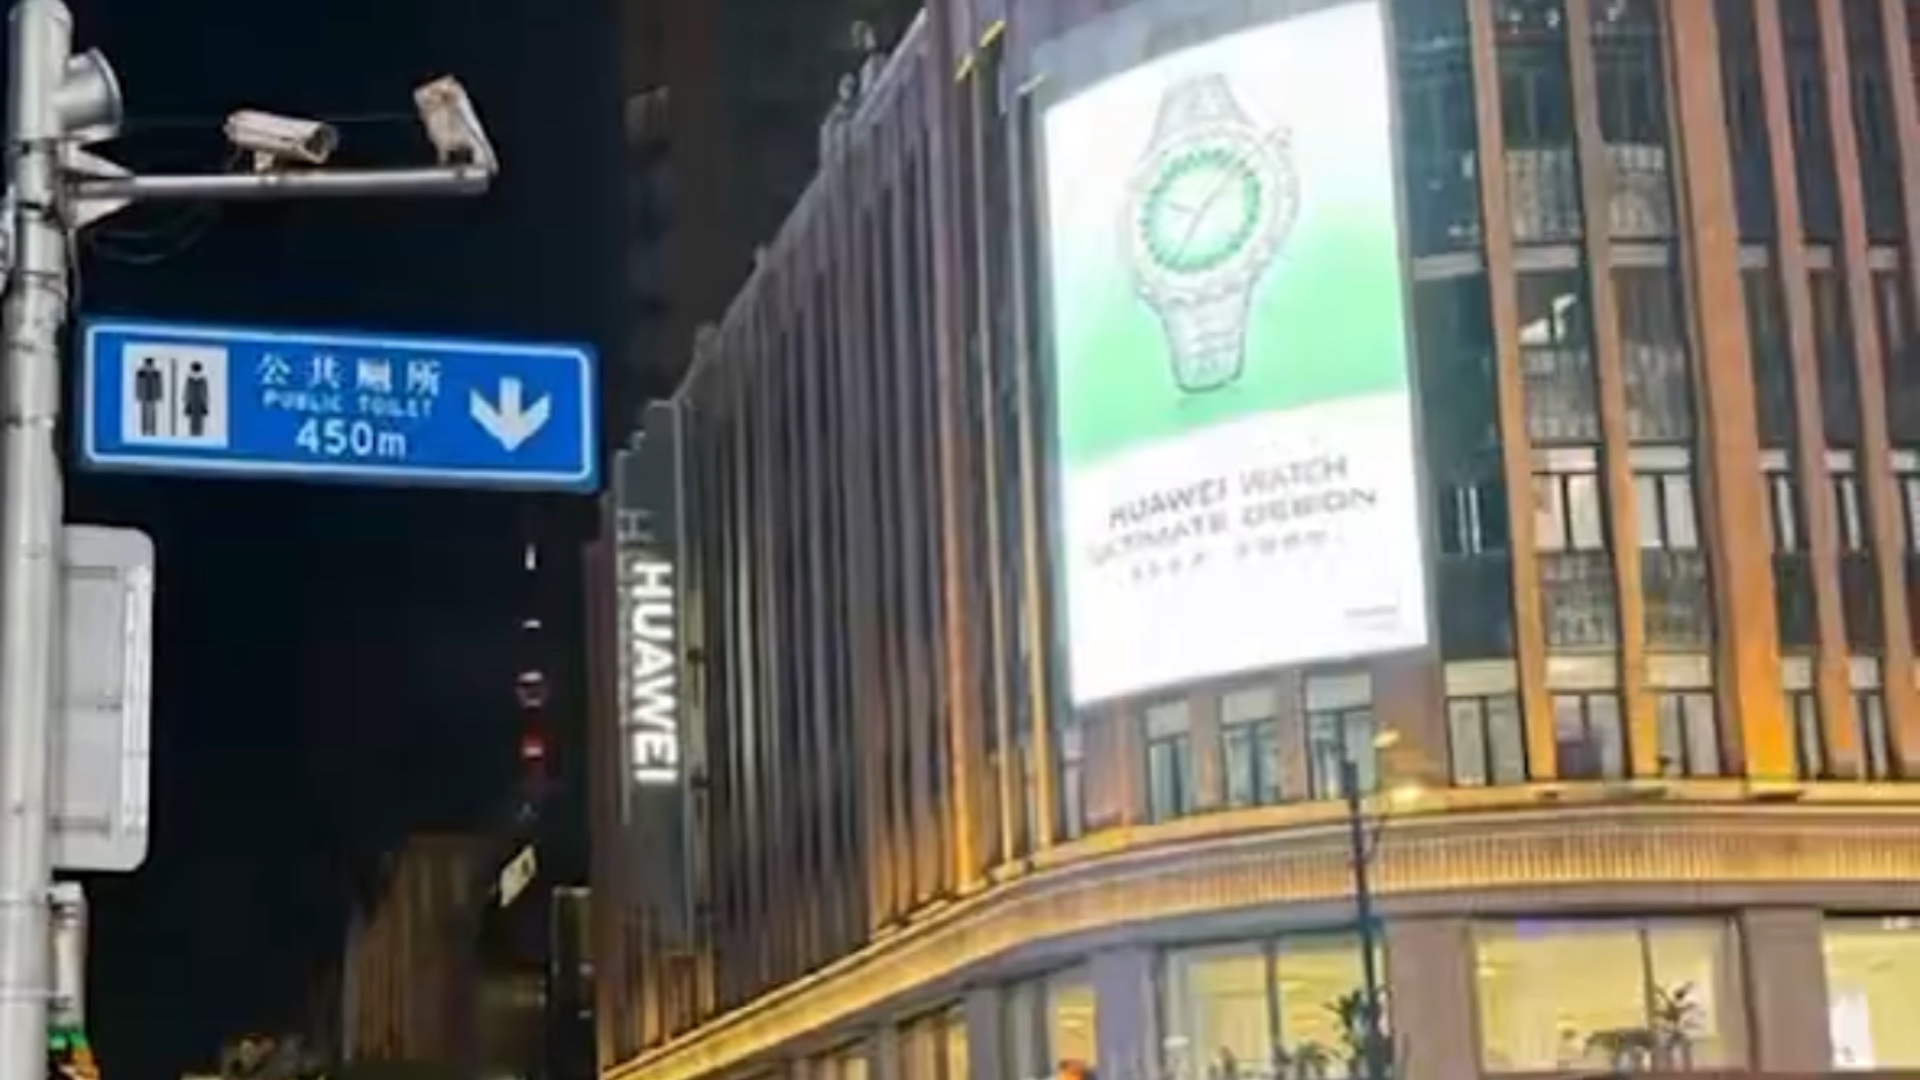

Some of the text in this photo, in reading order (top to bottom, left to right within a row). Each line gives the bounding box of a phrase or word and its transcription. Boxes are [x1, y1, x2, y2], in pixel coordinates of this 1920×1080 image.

[263, 388, 432, 418] PUBLIC TOILET
[296, 418, 406, 458] 450m
[1108, 455, 1348, 530] HUAWEI WATCH
[631, 560, 679, 784] HUAWEI
